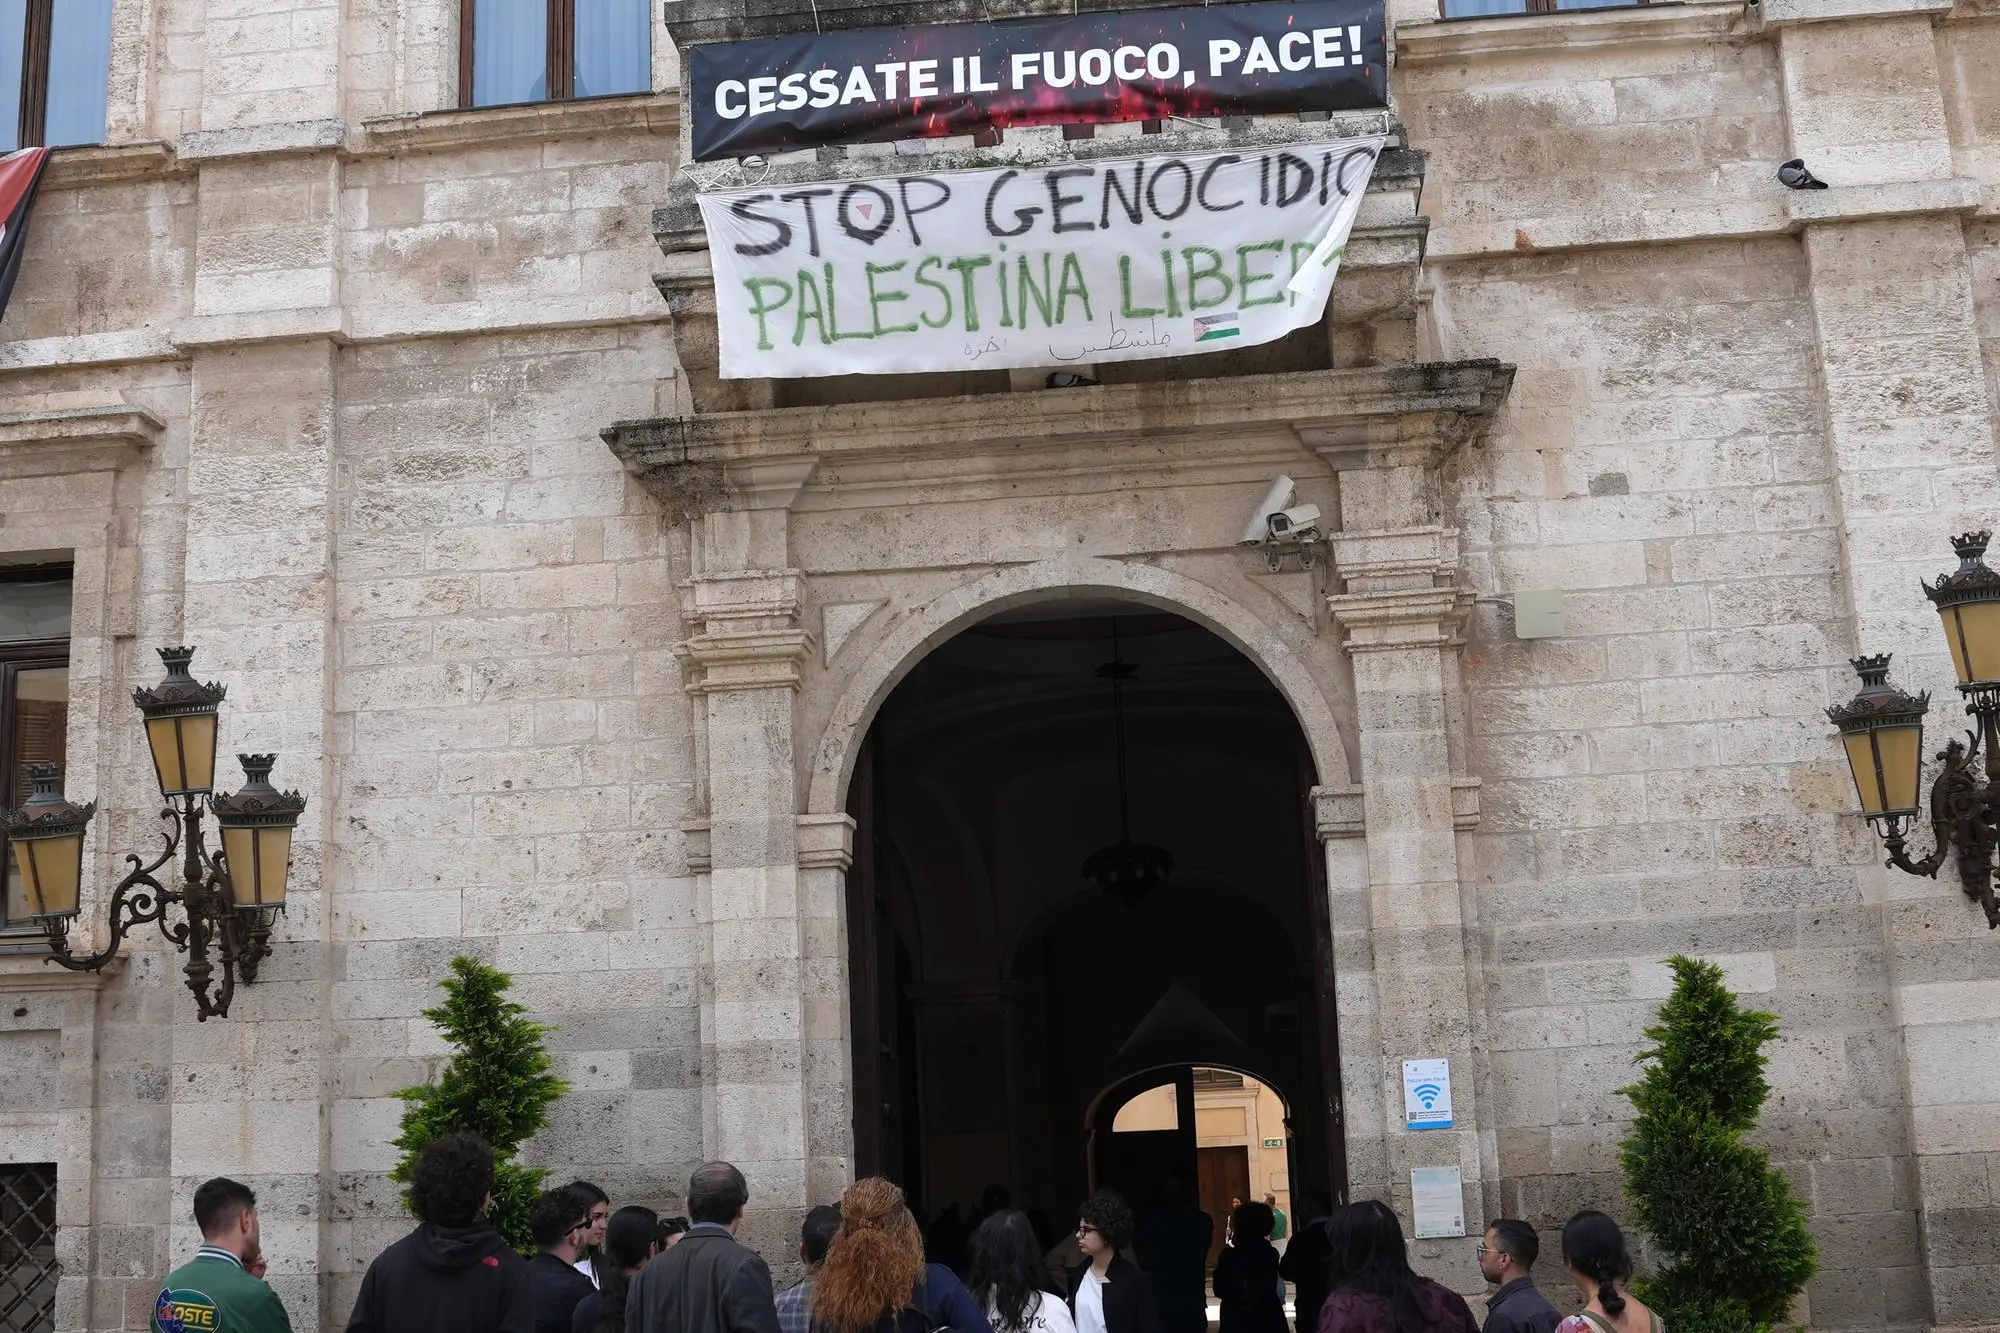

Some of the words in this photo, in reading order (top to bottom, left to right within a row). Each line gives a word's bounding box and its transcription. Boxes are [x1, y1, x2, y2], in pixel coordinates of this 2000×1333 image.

[714, 58, 939, 120] CESSATE
[952, 55, 999, 94] IL
[1010, 42, 1196, 91] FUOCO,
[1207, 25, 1363, 77] PACE!
[730, 177, 951, 257] STOP
